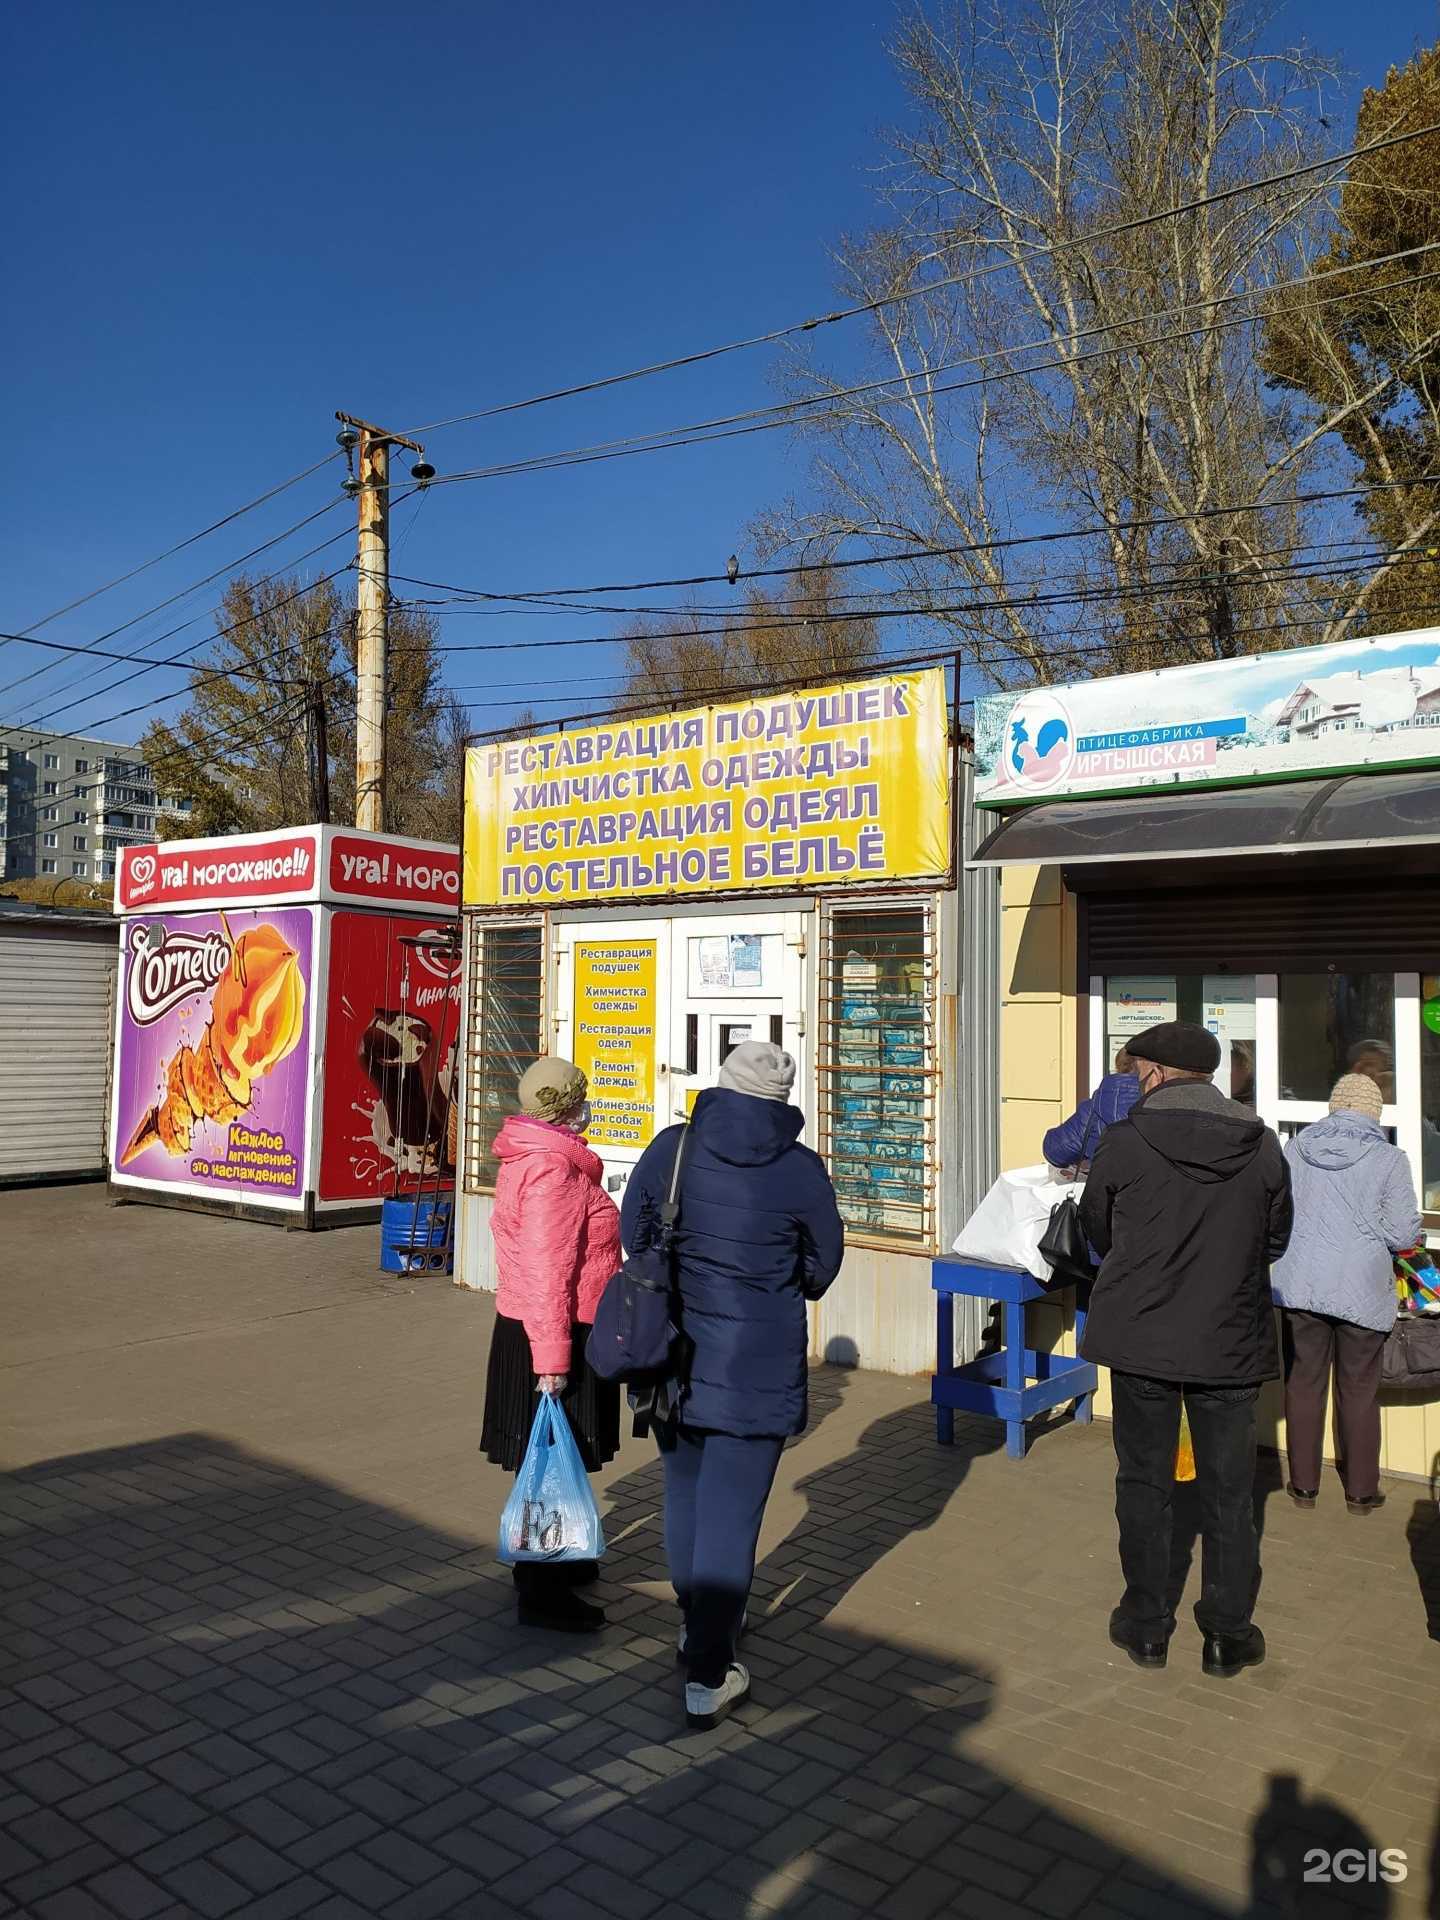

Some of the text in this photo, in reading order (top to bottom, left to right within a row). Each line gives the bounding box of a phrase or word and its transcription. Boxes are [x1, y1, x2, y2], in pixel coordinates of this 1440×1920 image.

[487, 683, 909, 778] РЕСТАВРАЦИЯ ПОДУШЕК
[1077, 725, 1205, 750] ПТИЦЕФАБРИКА
[1076, 743, 1206, 775] ИРТЫШСКАЯ
[512, 737, 870, 812] ХИМЧИСТКА ОДЕЖДЫ
[506, 783, 879, 853] РЕСТАВРАЦИЯ ОДЕЯЛ
[501, 826, 886, 897] ПОСТЕЛЬНОЕ БЕЛЬЁ
[580, 948, 653, 961] Реставрация
[591, 961, 641, 974] подушек
[131, 929, 230, 1020] Cornetto
[585, 986, 647, 998] Химчистка
[593, 1000, 638, 1012] одежды
[580, 1023, 652, 1036] Реставрация
[598, 1038, 632, 1049] одеял
[594, 1061, 635, 1073] Ремонт
[592, 1076, 638, 1088] одежды
[609, 1113, 643, 1126] собак
[230, 1127, 284, 1151] Каждое
[589, 1128, 640, 1140] на заказ
[192, 1161, 296, 1186] это наслаждение!
